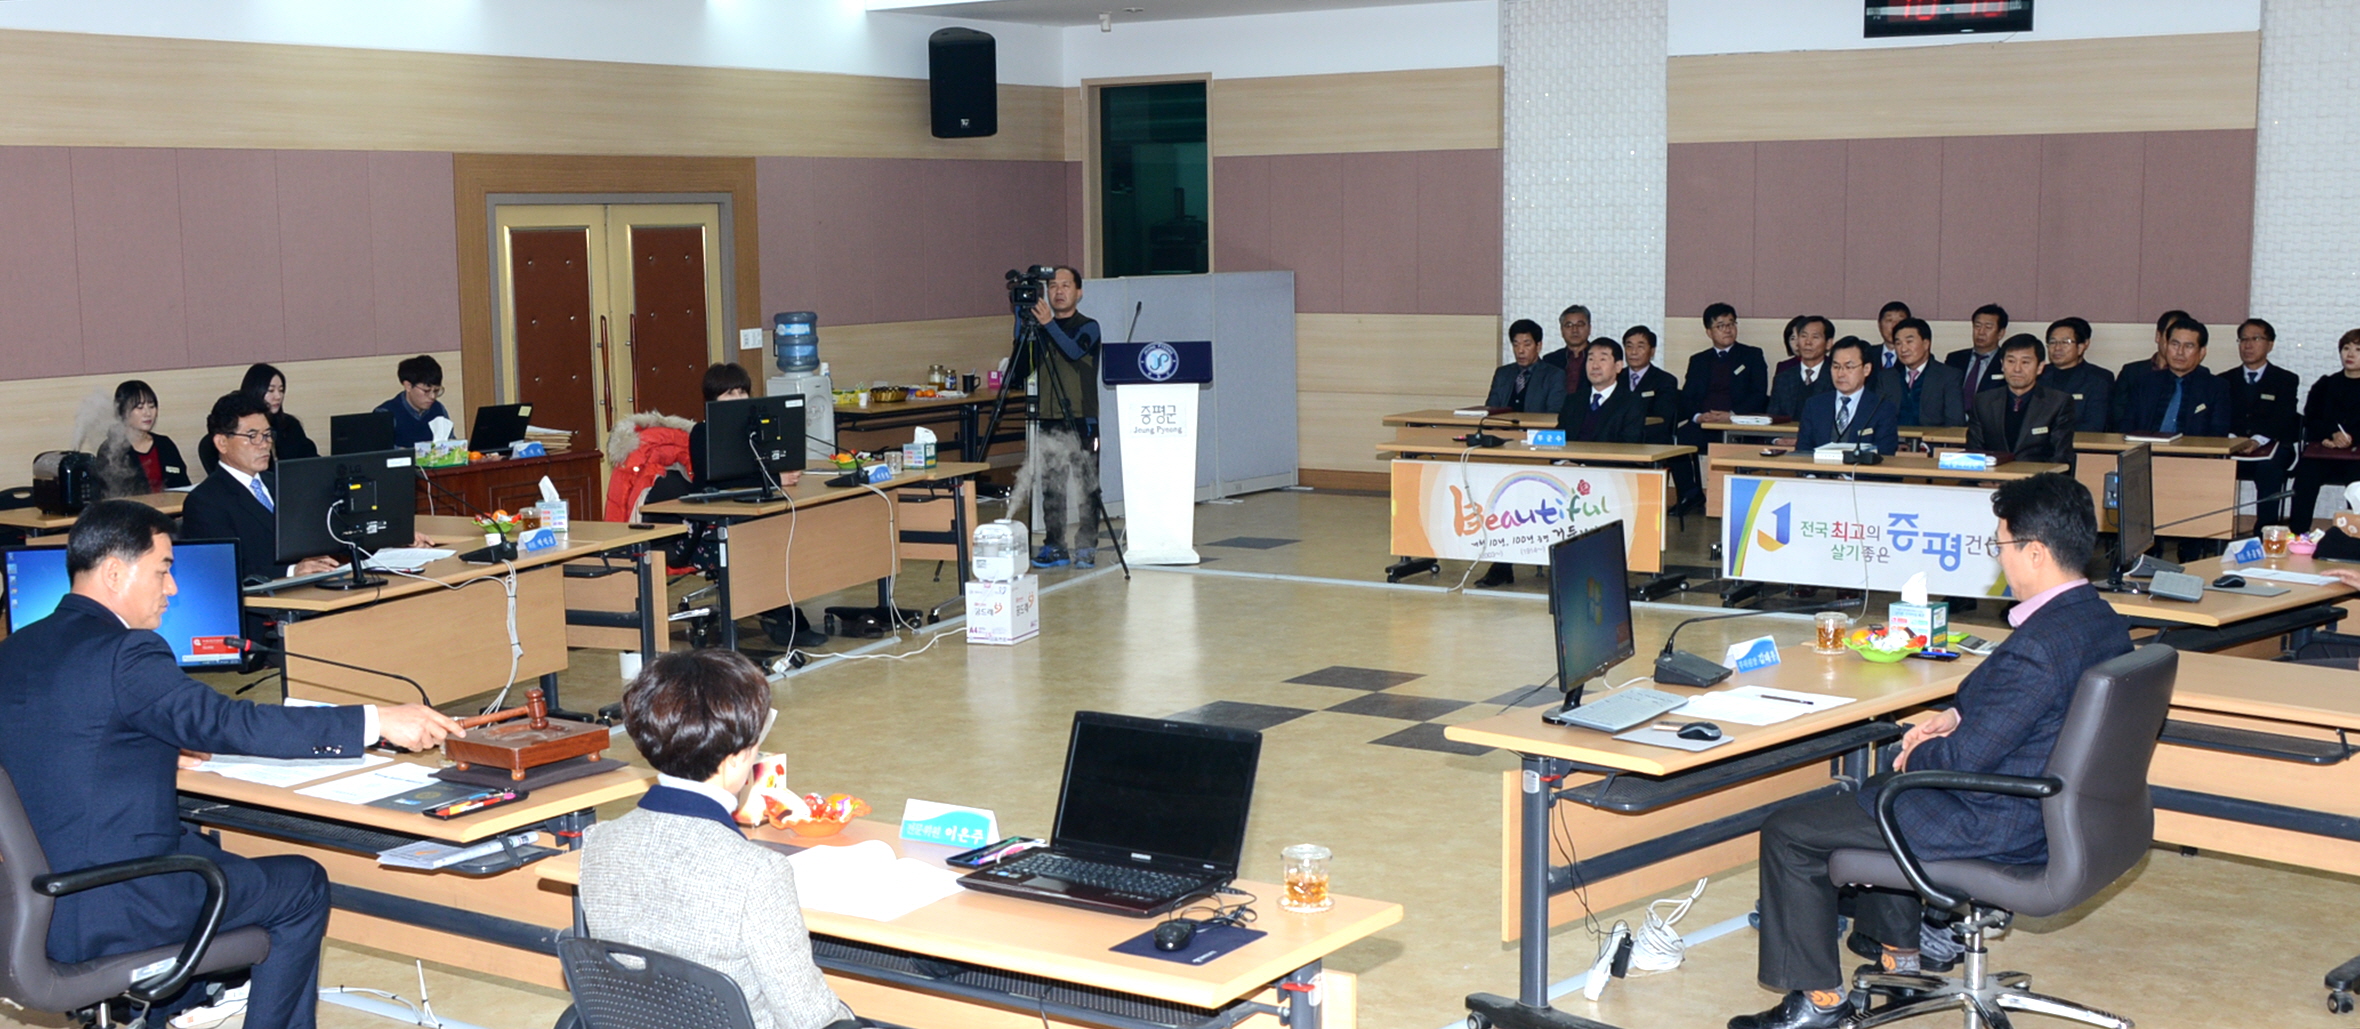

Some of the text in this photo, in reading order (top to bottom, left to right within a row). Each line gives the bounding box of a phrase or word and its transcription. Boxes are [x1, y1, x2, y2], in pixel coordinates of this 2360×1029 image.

[1141, 405, 1176, 425] 증평군
[1449, 485, 1611, 537] Beautiful
[1800, 520, 1881, 542] 전국 최고의
[1886, 512, 1962, 572] 증평
[1830, 543, 1891, 564] 살기좋은
[944, 825, 985, 845] 이은주
